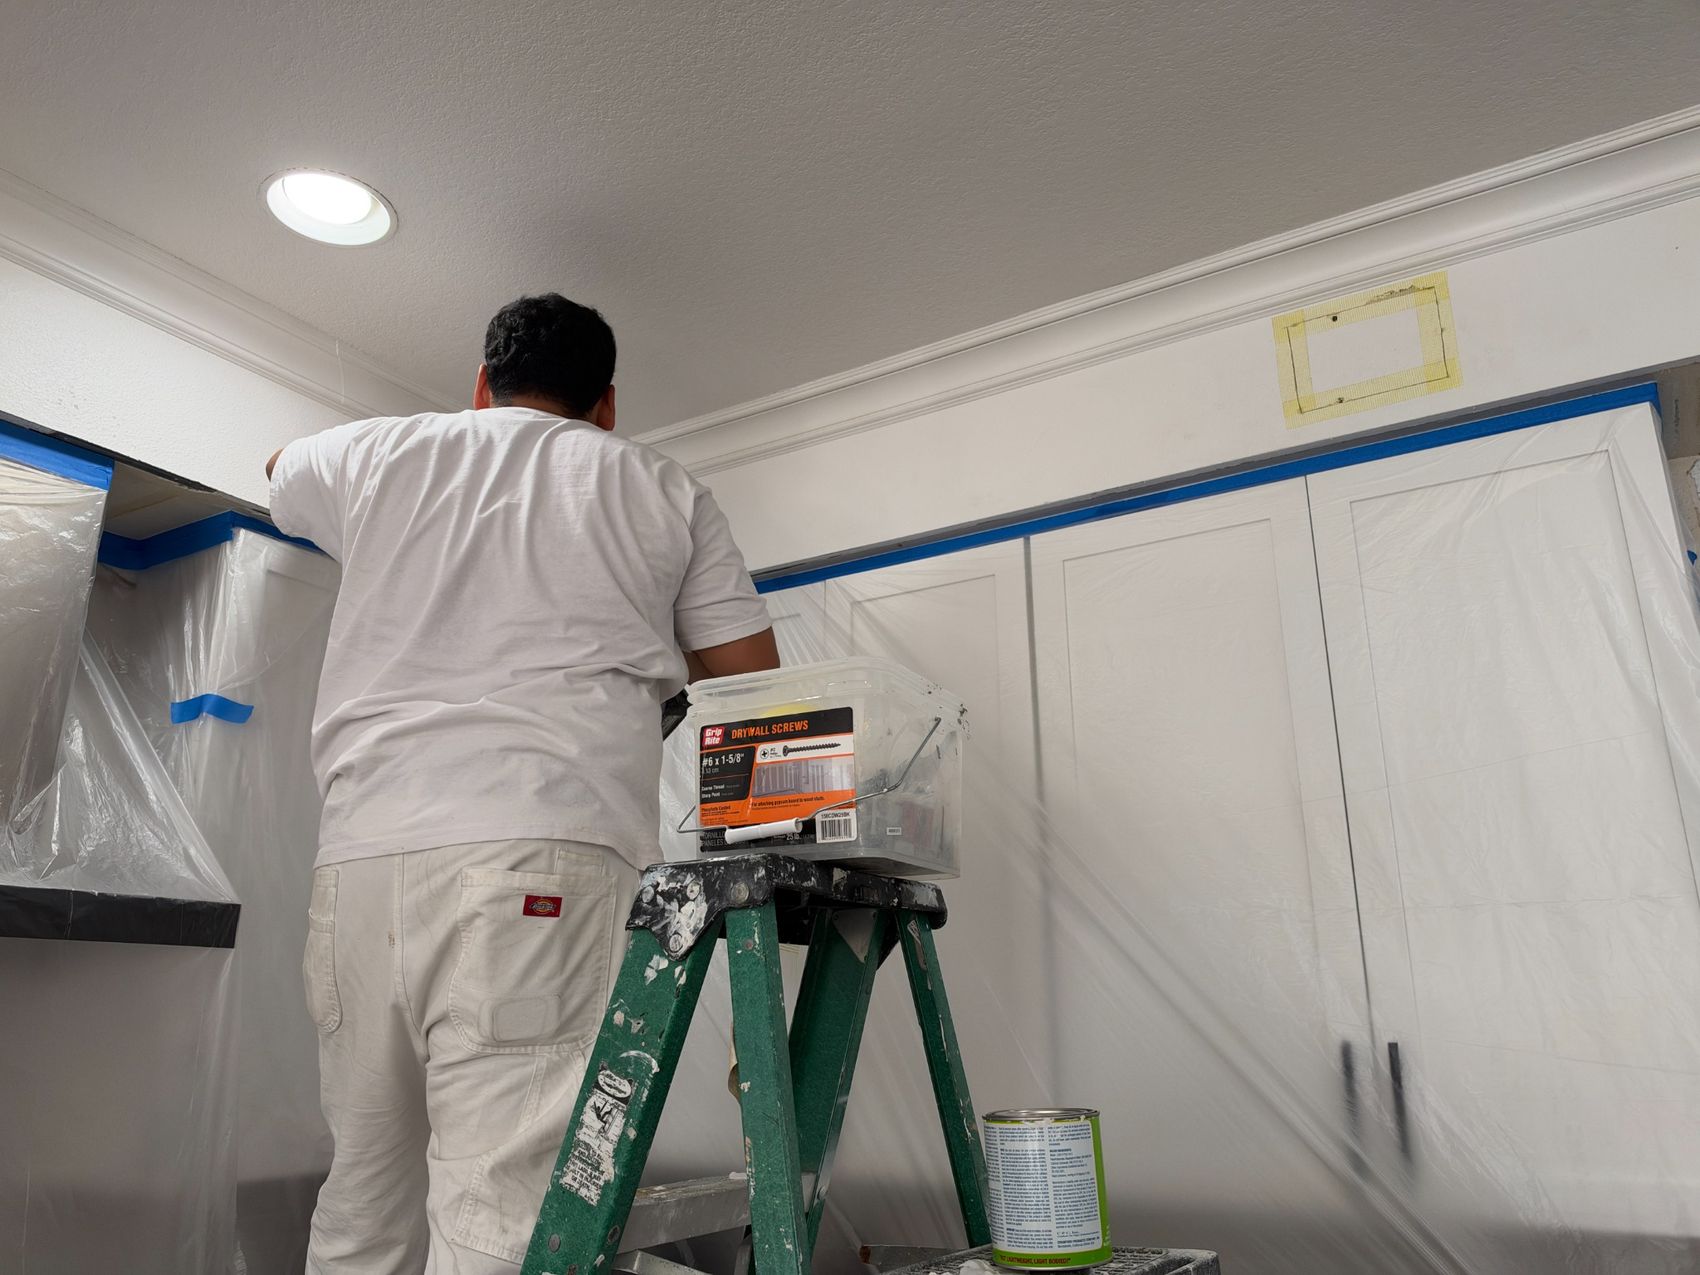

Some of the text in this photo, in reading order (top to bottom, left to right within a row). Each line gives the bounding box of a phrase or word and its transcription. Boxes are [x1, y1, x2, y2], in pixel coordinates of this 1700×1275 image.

[705, 728, 723, 737] Grip
[731, 720, 809, 740] DRYWALL SCREWS
[704, 737, 721, 746] Rite
[702, 757, 713, 767] #6
[715, 758, 720, 766] x
